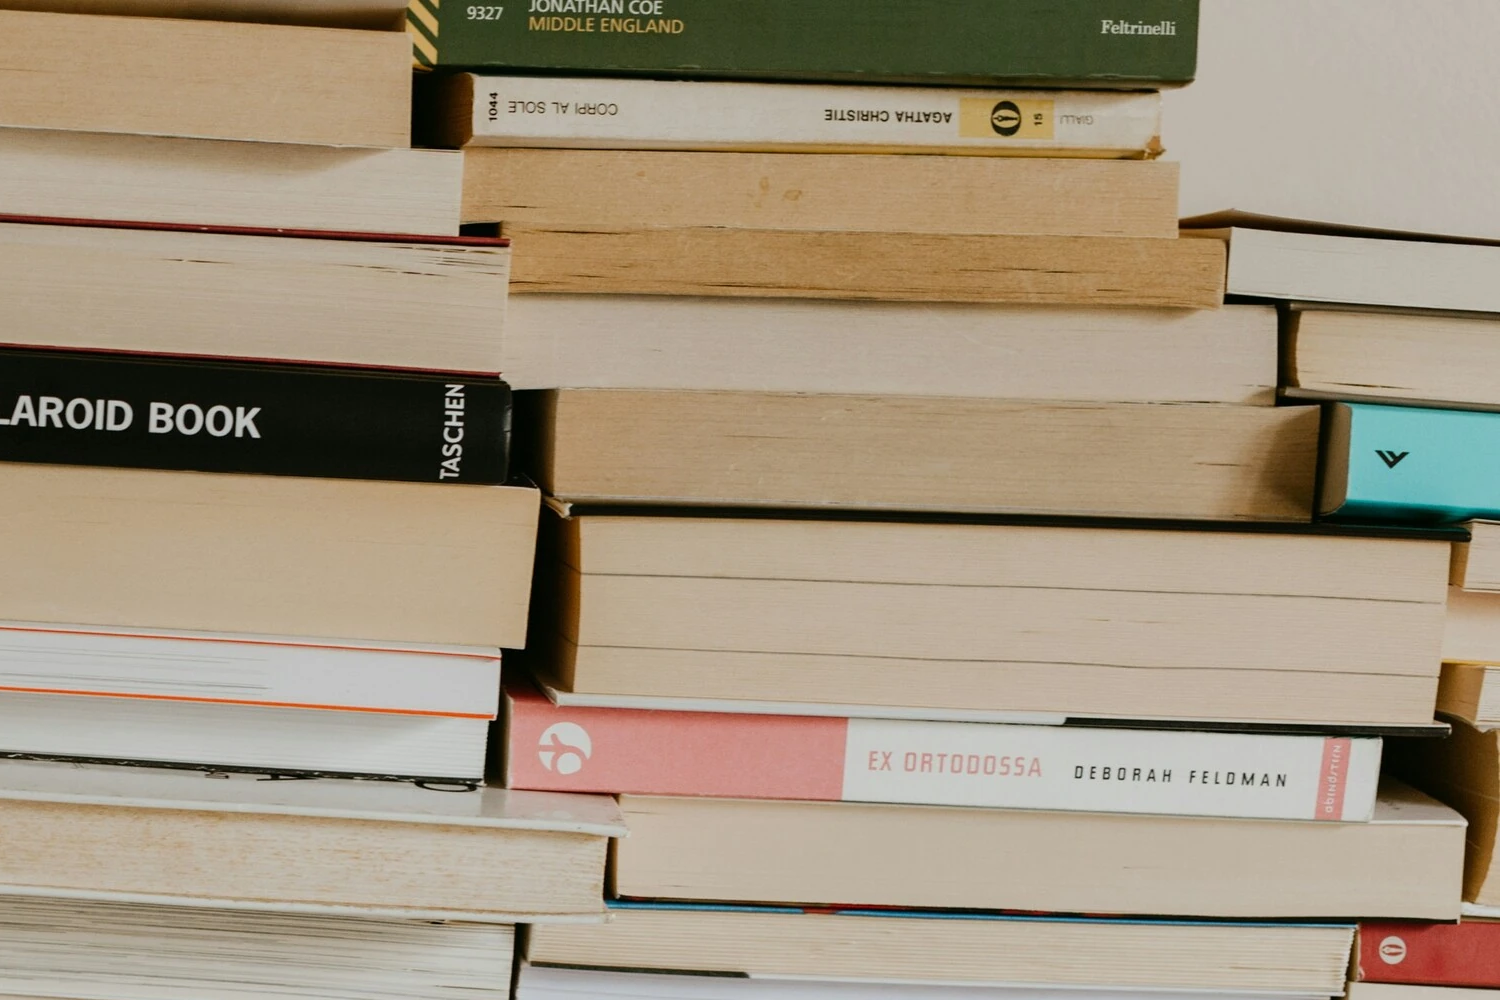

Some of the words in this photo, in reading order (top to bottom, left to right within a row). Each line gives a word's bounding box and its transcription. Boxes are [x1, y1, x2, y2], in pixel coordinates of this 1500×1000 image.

[467, 6, 503, 20] 9327
[528, 0, 624, 14] JONATHAN
[628, 0, 663, 15] COE
[528, 16, 594, 32] MIDDLE
[601, 17, 684, 34] ENGLAND
[1101, 19, 1176, 36] Feltrinelli
[488, 92, 498, 122] 1044
[508, 100, 546, 114] SOLE
[552, 102, 568, 115] AL
[575, 103, 618, 116] CORPI
[824, 108, 890, 123] CHRISTIE
[895, 110, 953, 124] AGATHA
[1059, 114, 1094, 126] GIALLI
[148, 402, 262, 438] BOOK
[439, 384, 465, 480] TASCHEN
[868, 750, 893, 772] EX
[903, 752, 1042, 778] ORTODOSSA
[1074, 765, 1171, 782] DEBORAH
[1189, 770, 1287, 787] FELDMAN
